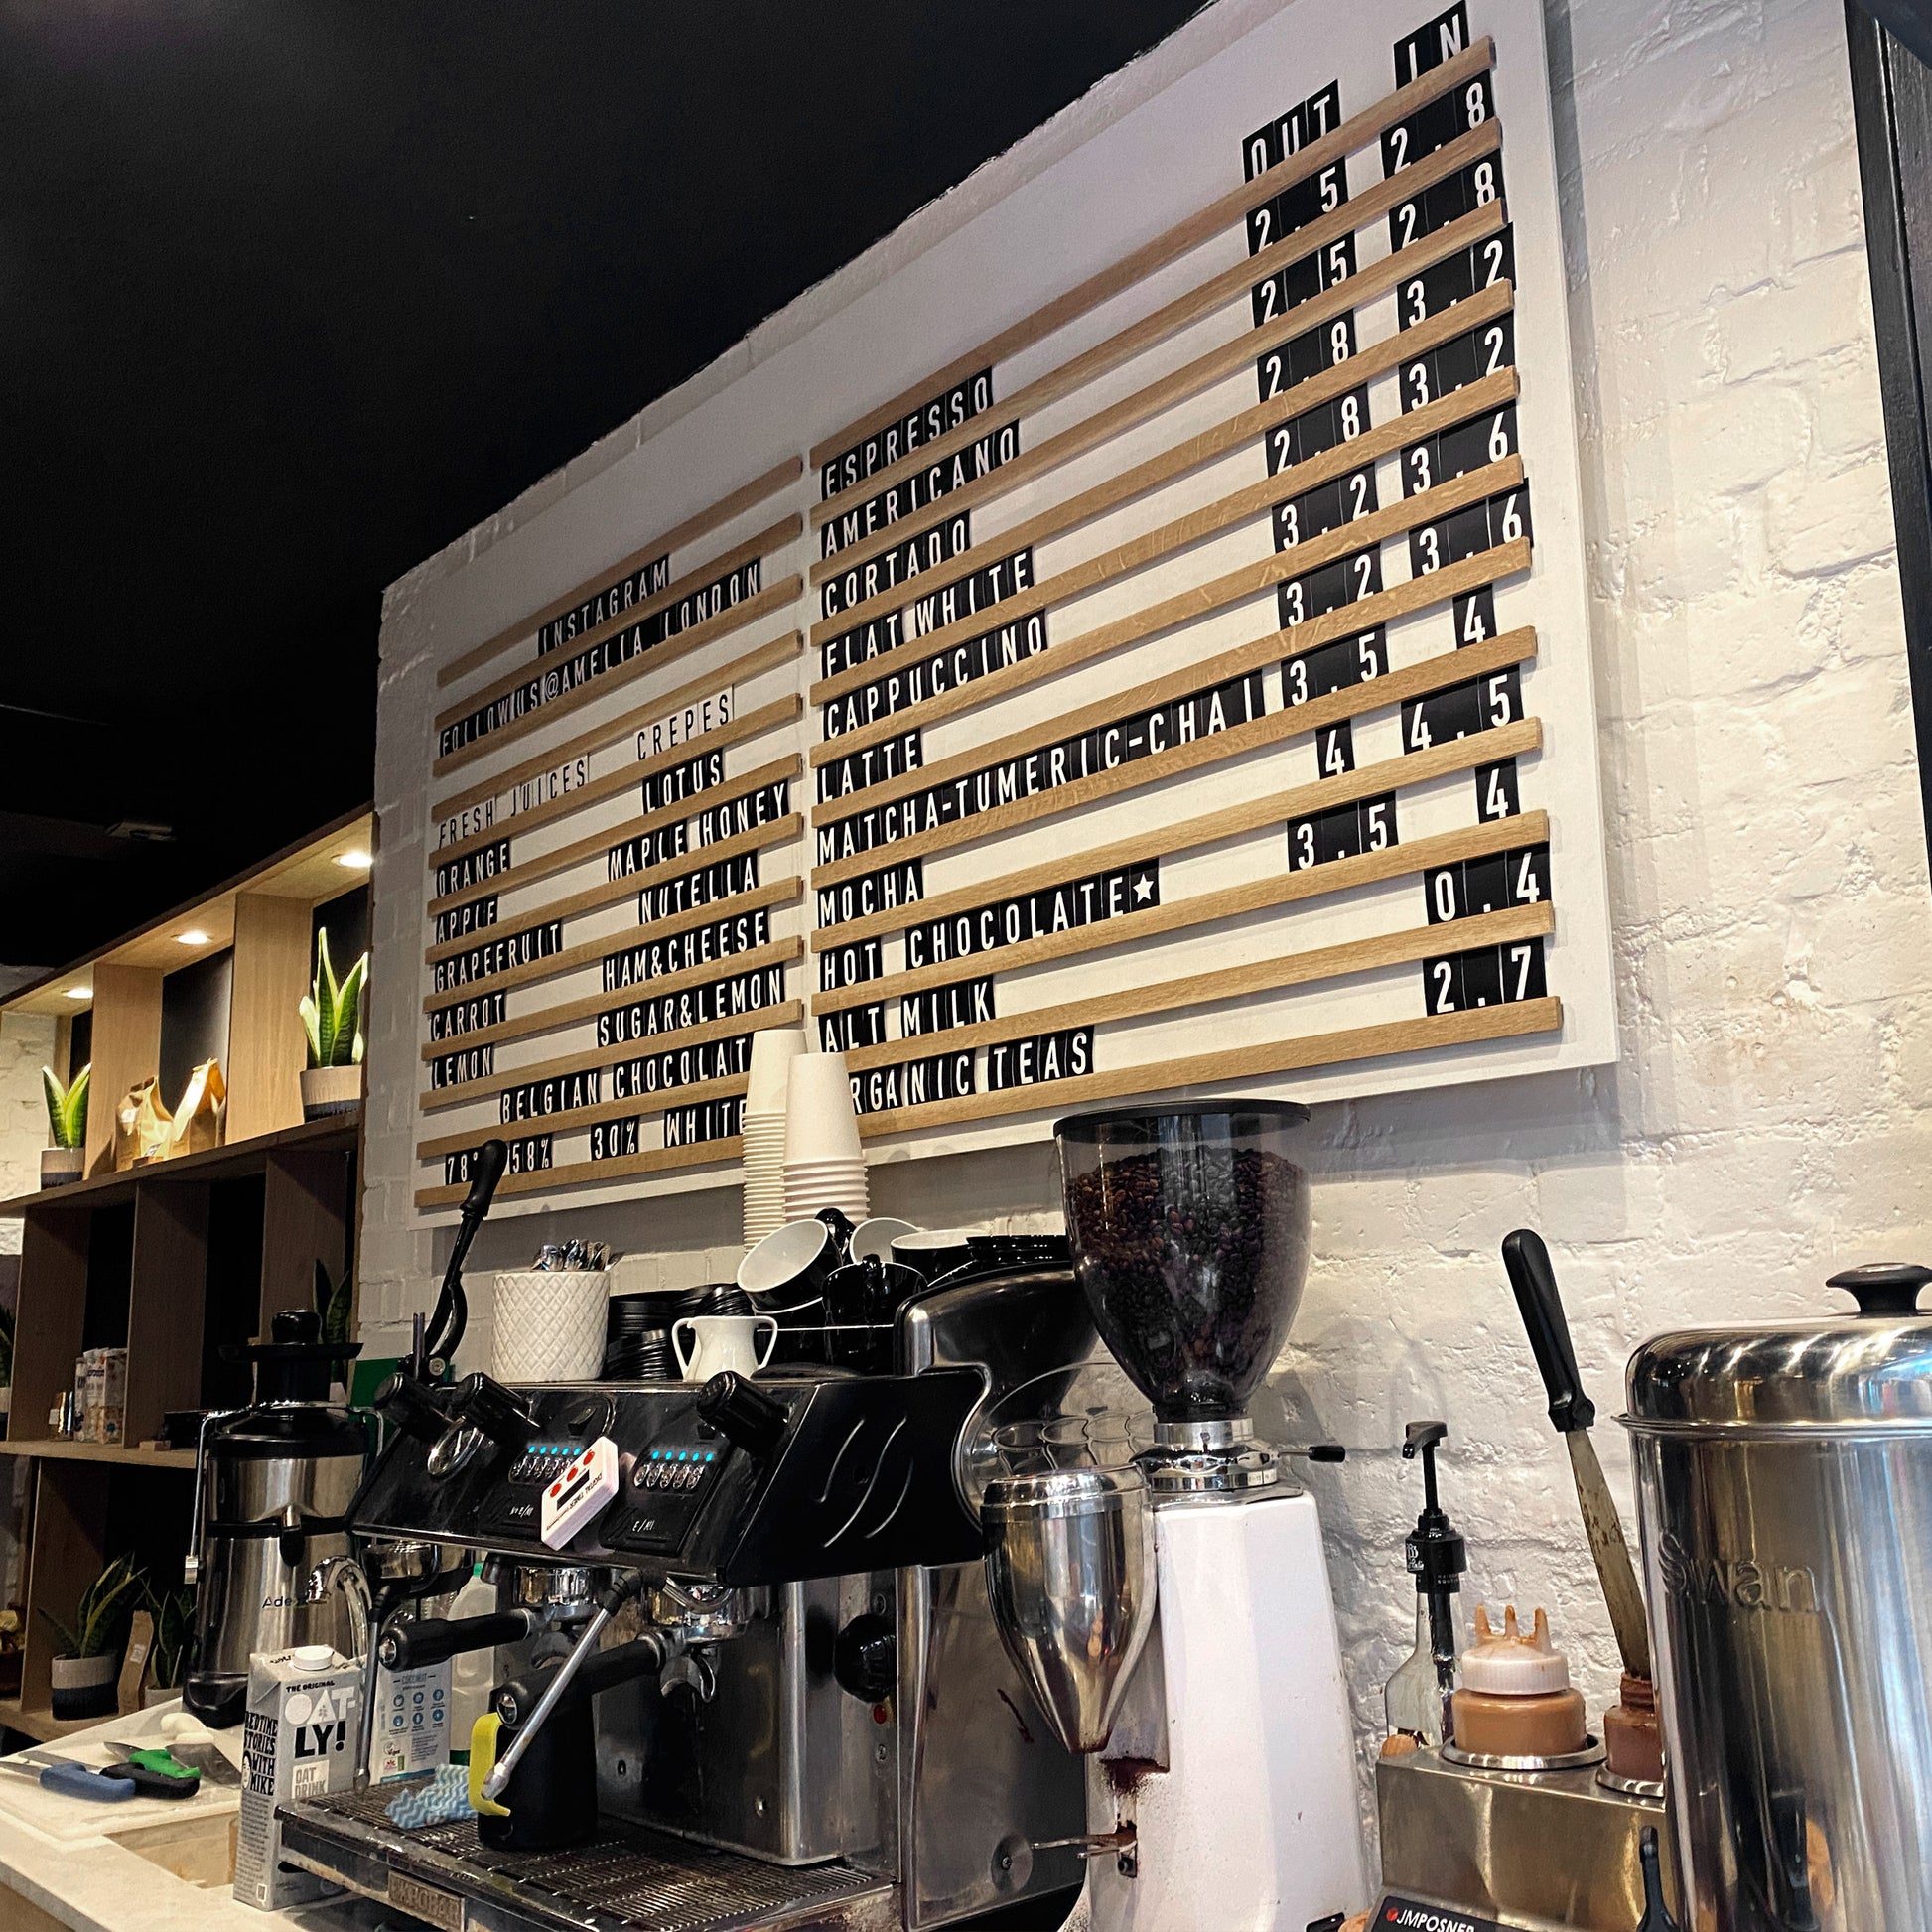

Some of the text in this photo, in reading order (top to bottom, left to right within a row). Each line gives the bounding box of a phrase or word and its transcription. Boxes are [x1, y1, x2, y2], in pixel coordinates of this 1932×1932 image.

[1251, 13, 1461, 178] OUT IN
[825, 427, 1014, 558] AMERICANO
[1399, 162, 1495, 248] 2.8
[826, 82, 1485, 498] ESPRESSO 2.5 2.8
[825, 239, 1504, 617] CORTADO 2.8 3.2
[826, 326, 1504, 677] FLAT WHITE 2.8 3.2
[542, 559, 668, 652] INSTAGRAM
[827, 412, 1508, 739] CAPPUCCINO 3.2 3.6
[822, 493, 1522, 802] LATTE 3.2 3.6
[439, 694, 729, 849] FRESH JUICES CREPES
[819, 596, 1485, 866] MATCHA-TUMERIC-CHAI 3.5 4
[820, 674, 1510, 927] MOCHA 4 4.5
[438, 783, 785, 944] APPLE MAPLE HONEY
[439, 754, 720, 897] ORANGE LOTUS
[824, 768, 1509, 990] HOT CHOCOLATE 3.5 4
[433, 911, 764, 1041] CARROT HAM&CHEESE
[437, 857, 755, 992] GRAPEFRUIT NUTELLA
[825, 852, 1540, 1052] ALT MILK 0.4
[435, 968, 781, 1089] LEMON SUGAR&LEMON
[503, 1038, 746, 1123] BELGIAN CHOCOLAT
[850, 946, 1531, 1114] RGANIC TEAS 2.7
[512, 1138, 549, 1173] 58%
[594, 1120, 635, 1160] 30%
[666, 1099, 747, 1147] WHITE
[244, 1730, 276, 1755] STORIES
[245, 1711, 278, 1736] BEDTIME
[295, 1720, 346, 1759] LY!
[302, 1680, 336, 1691] ORIGINAL
[250, 1773, 274, 1796] MIKE
[252, 1753, 275, 1776] WITH
[295, 1767, 317, 1783] OAT
[295, 1780, 327, 1799] DRINK
